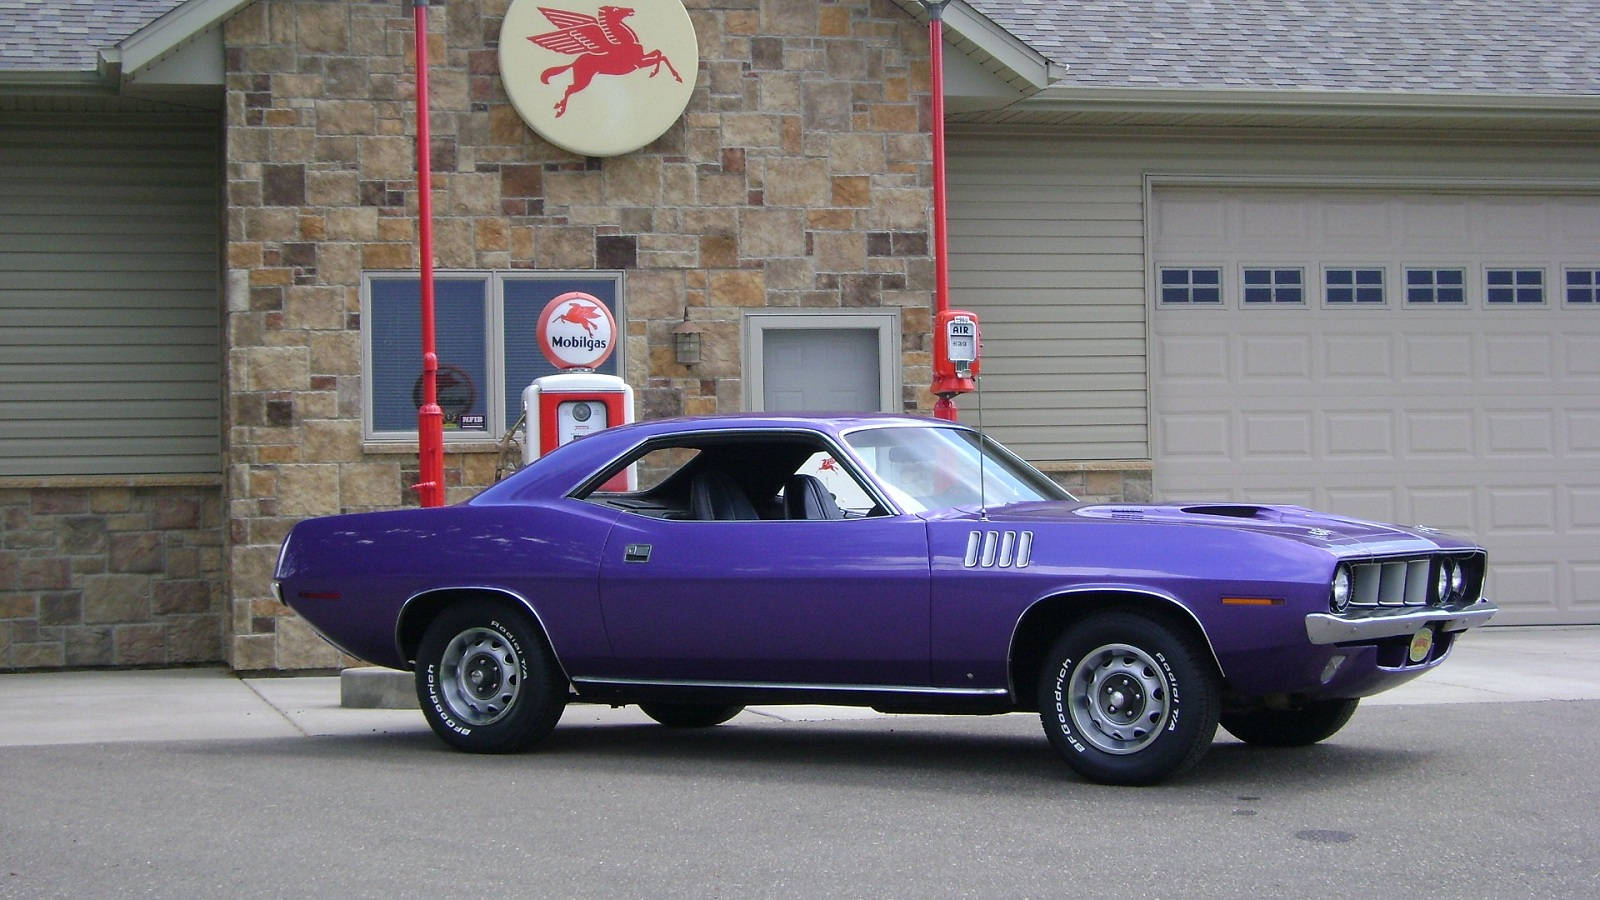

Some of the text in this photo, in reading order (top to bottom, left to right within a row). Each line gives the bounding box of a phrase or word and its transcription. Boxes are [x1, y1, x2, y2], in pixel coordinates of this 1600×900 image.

[552, 336, 606, 351] Mobilgas
[953, 326, 969, 334] AIR
[491, 620, 523, 654] Radial
[427, 664, 471, 736] BFGoodrich
[1054, 658, 1085, 753] BFGoodrich
[1156, 652, 1179, 731] Radial T/A
